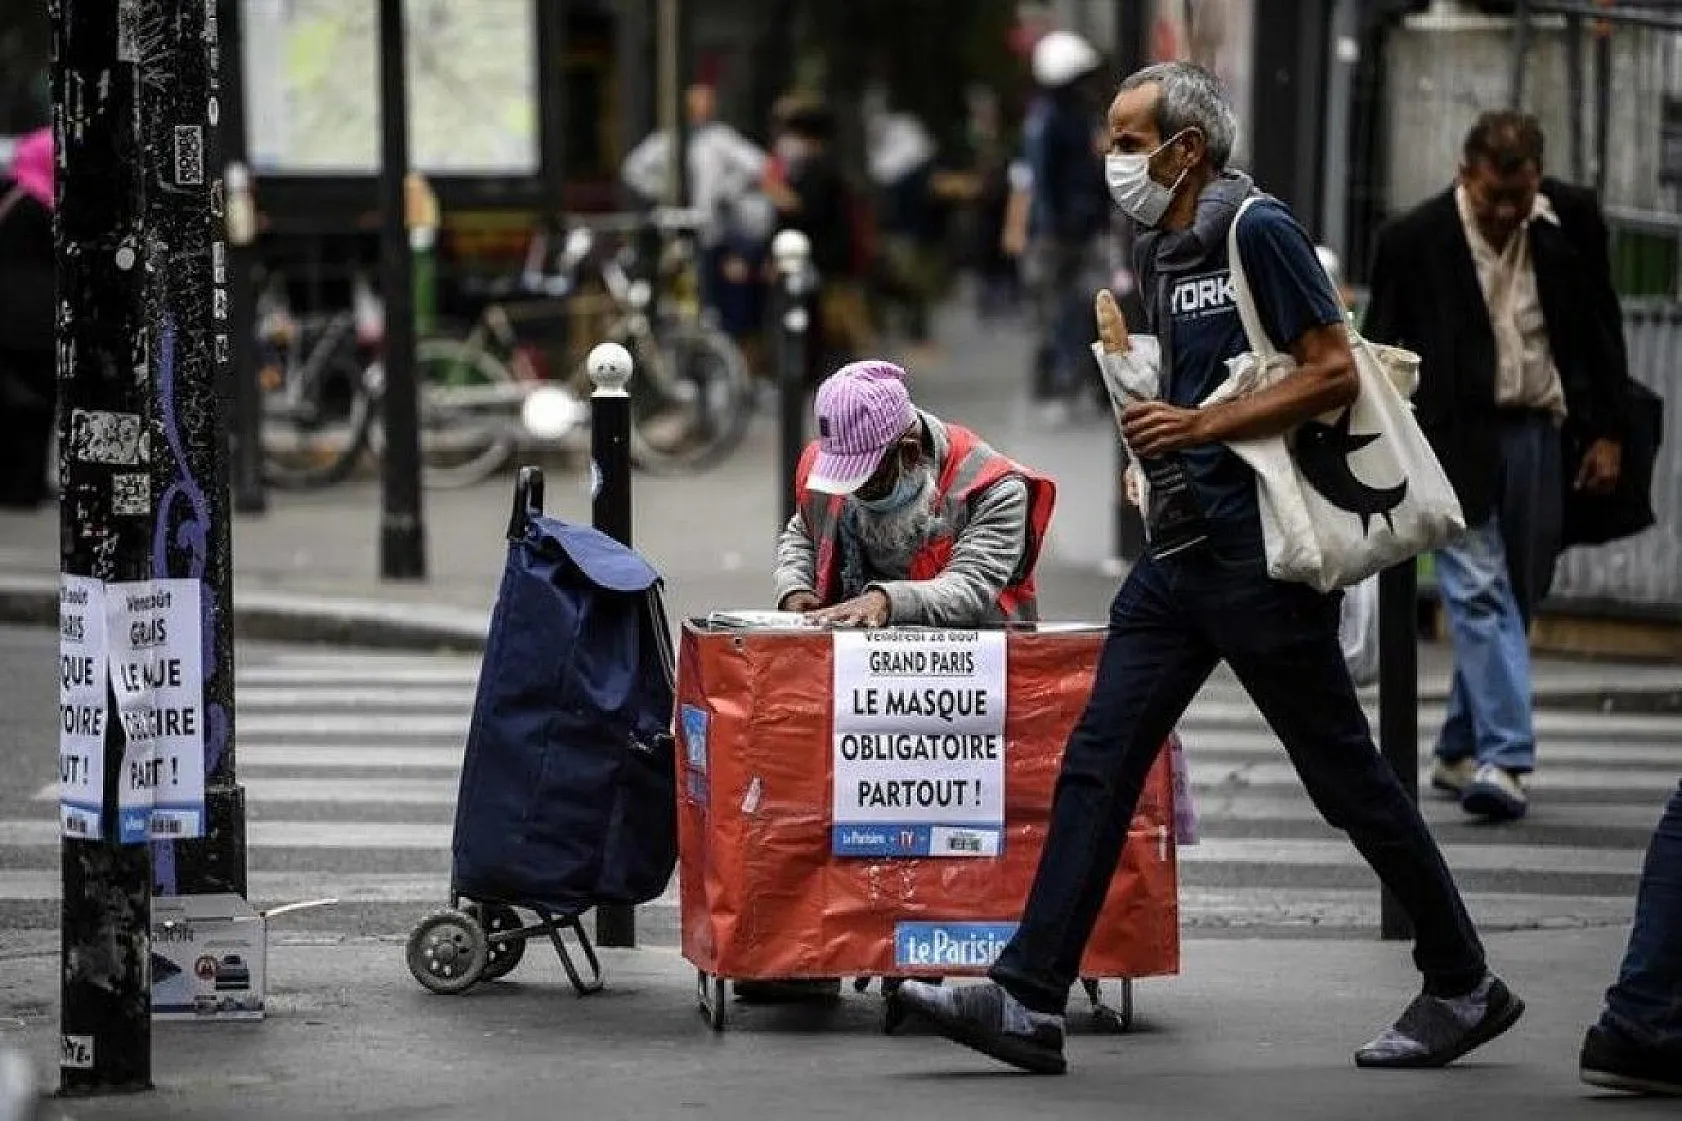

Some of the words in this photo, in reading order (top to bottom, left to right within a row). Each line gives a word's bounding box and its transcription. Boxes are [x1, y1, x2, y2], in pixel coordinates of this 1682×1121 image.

[870, 651, 926, 673] GRAND
[931, 651, 974, 674] PARIS
[854, 689, 878, 714] LE
[886, 689, 987, 721] MASQUE
[841, 735, 997, 760] OBLIGATOIRE
[858, 781, 967, 807] PARTOUT
[975, 781, 982, 806] !
[909, 935, 930, 964] Le
